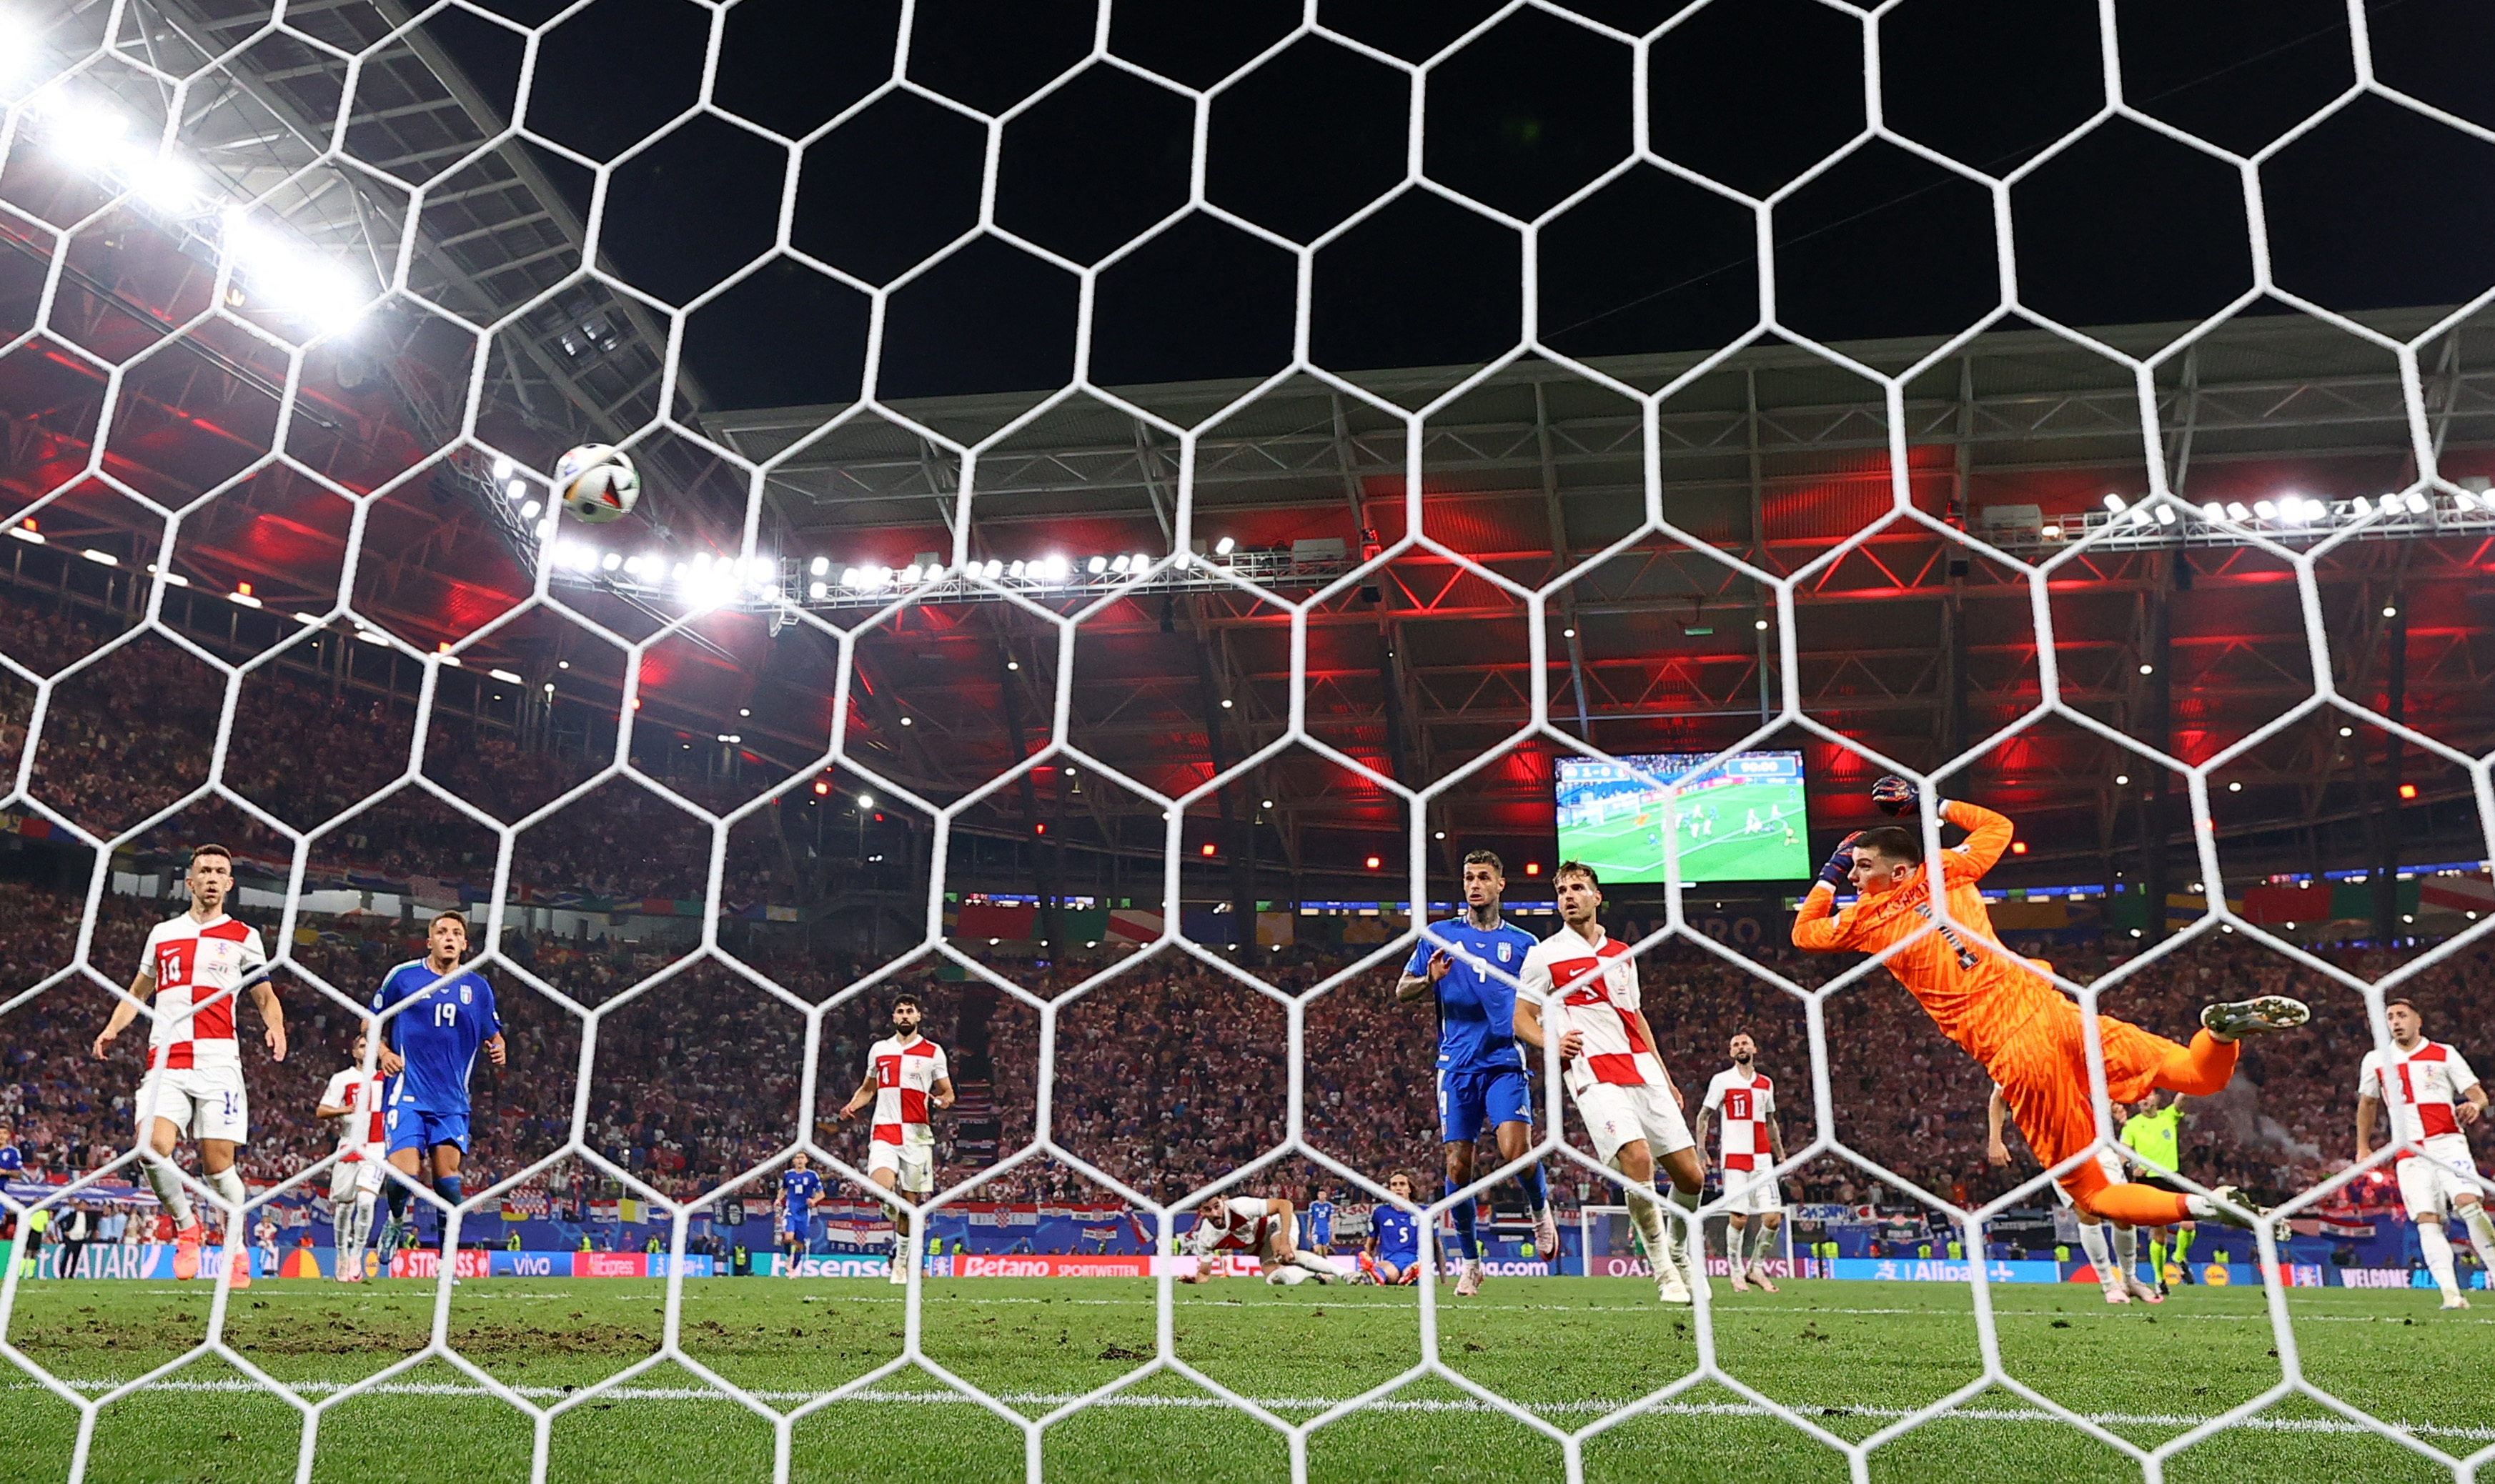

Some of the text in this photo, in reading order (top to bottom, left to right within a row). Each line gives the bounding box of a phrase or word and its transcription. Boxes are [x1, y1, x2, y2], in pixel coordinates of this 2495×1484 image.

[1740, 761, 1779, 773] 90:00
[160, 955, 182, 986] 14
[1470, 957, 1487, 983] 9
[434, 1002, 457, 1027] 19
[1439, 1090, 1448, 1116] 9
[1733, 1100, 1746, 1117] 11
[1768, 1183, 1779, 1200] 11
[1399, 1226, 1409, 1243] 5
[407, 1251, 475, 1278] STRSS
[513, 1253, 550, 1276] vivo
[770, 1253, 892, 1278] Hsense
[965, 1257, 1139, 1278] Betano SPORTWETTEN
[2340, 1268, 2411, 1289] WELCOME
